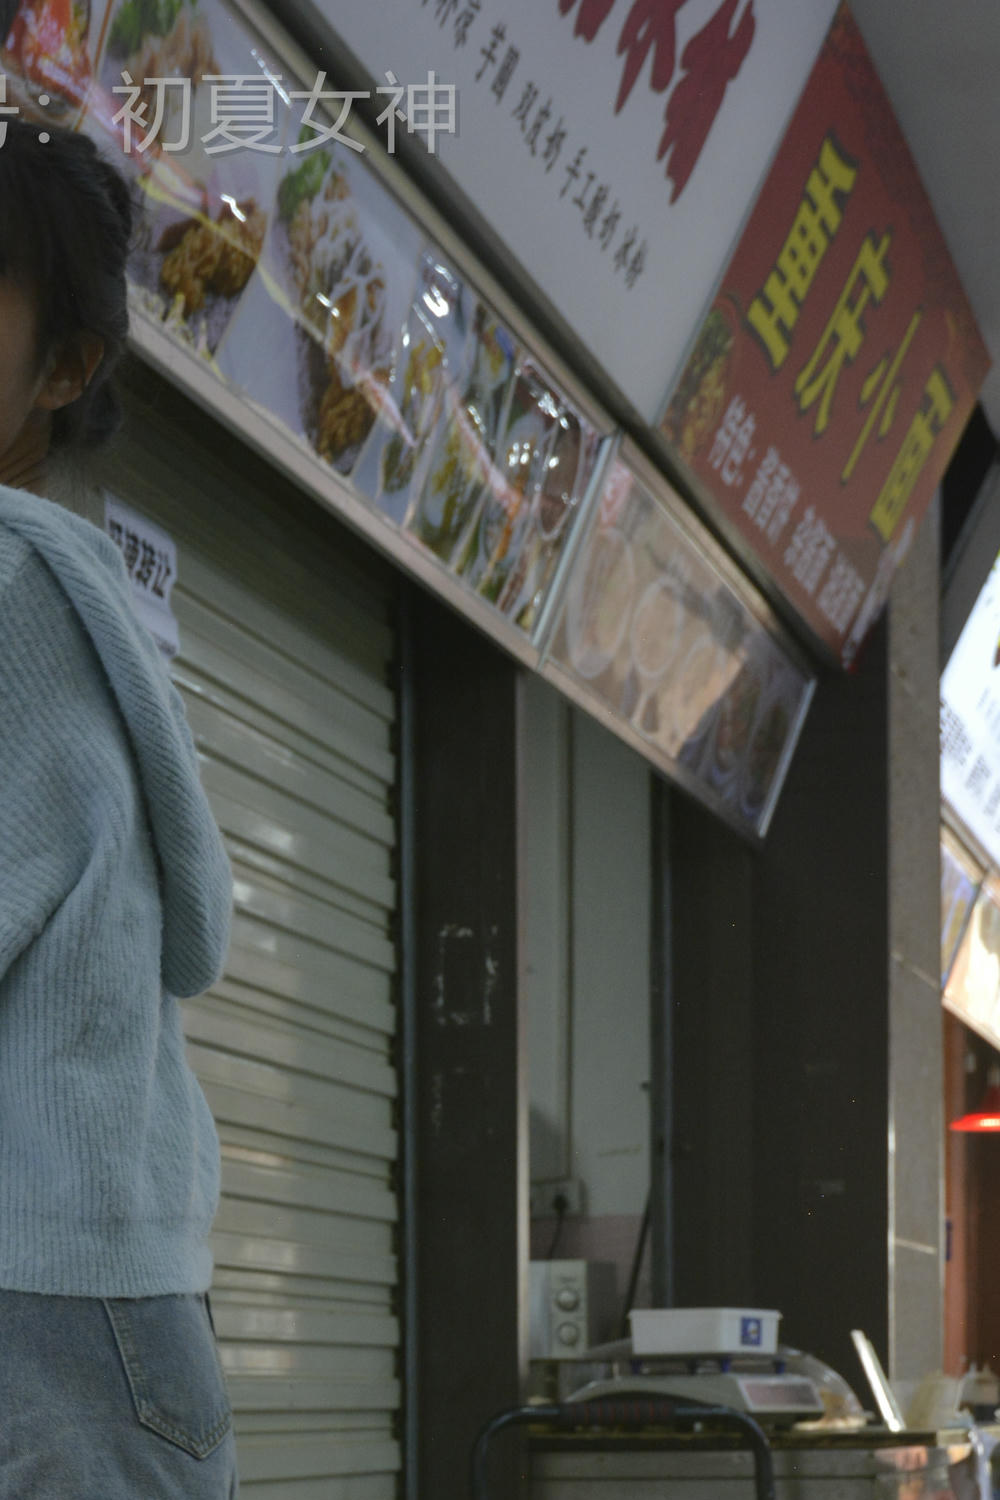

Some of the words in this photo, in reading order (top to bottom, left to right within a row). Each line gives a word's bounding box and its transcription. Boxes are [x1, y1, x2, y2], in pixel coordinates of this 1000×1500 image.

[511, 80, 567, 174] 双皮奶
[559, 146, 621, 252] 手工酸奶
[747, 132, 956, 540] 重庆小面
